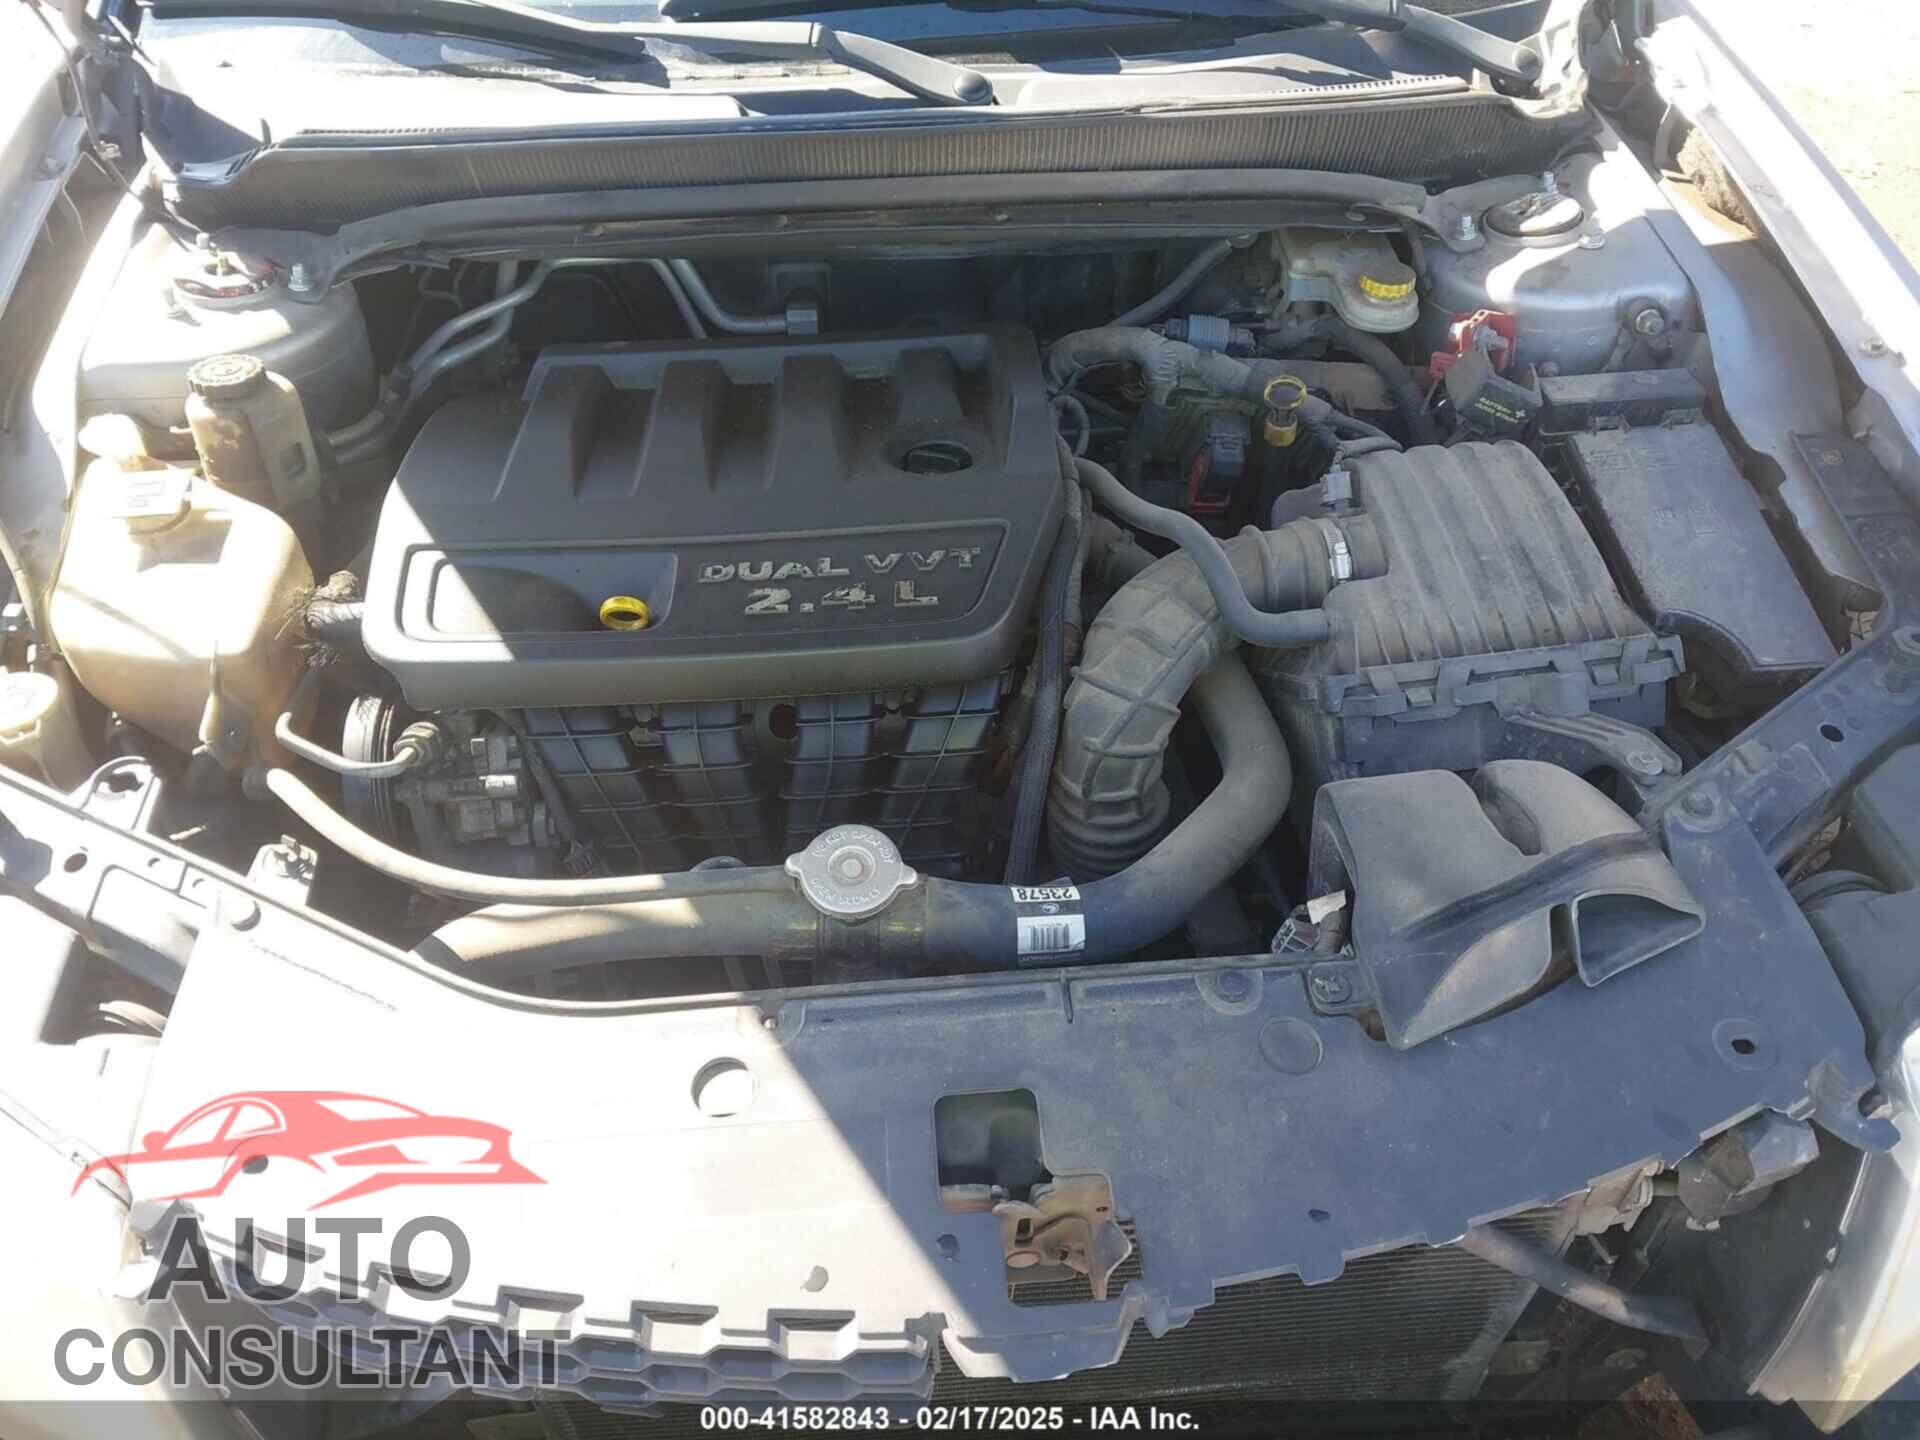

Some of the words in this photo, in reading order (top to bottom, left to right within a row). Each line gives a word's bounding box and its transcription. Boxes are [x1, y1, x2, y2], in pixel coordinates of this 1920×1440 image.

[697, 556, 851, 583] DUAL
[863, 546, 982, 574] VVT
[1016, 888, 1073, 901] 23578
